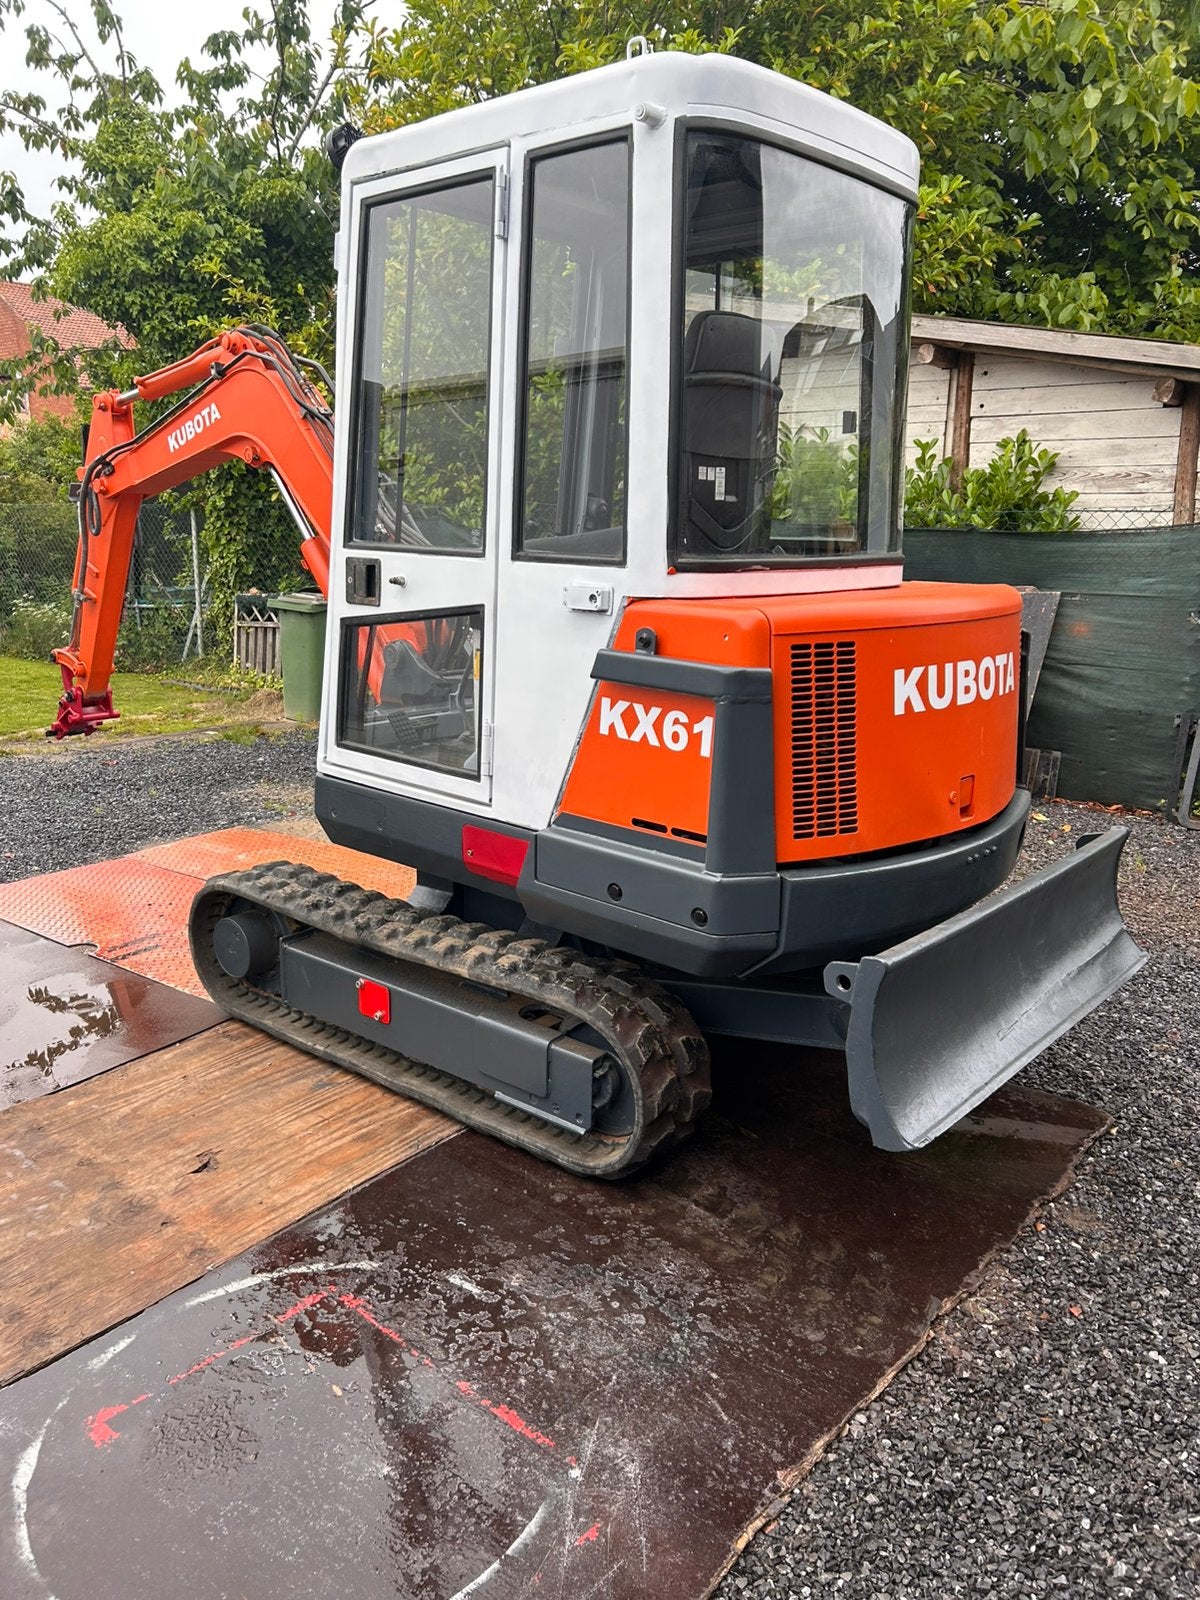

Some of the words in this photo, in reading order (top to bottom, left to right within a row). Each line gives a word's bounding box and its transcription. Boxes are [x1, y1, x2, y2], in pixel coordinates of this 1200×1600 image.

[168, 402, 221, 453] KUBOTA
[894, 651, 1014, 716] KUBOTA
[599, 696, 714, 758] KX61
